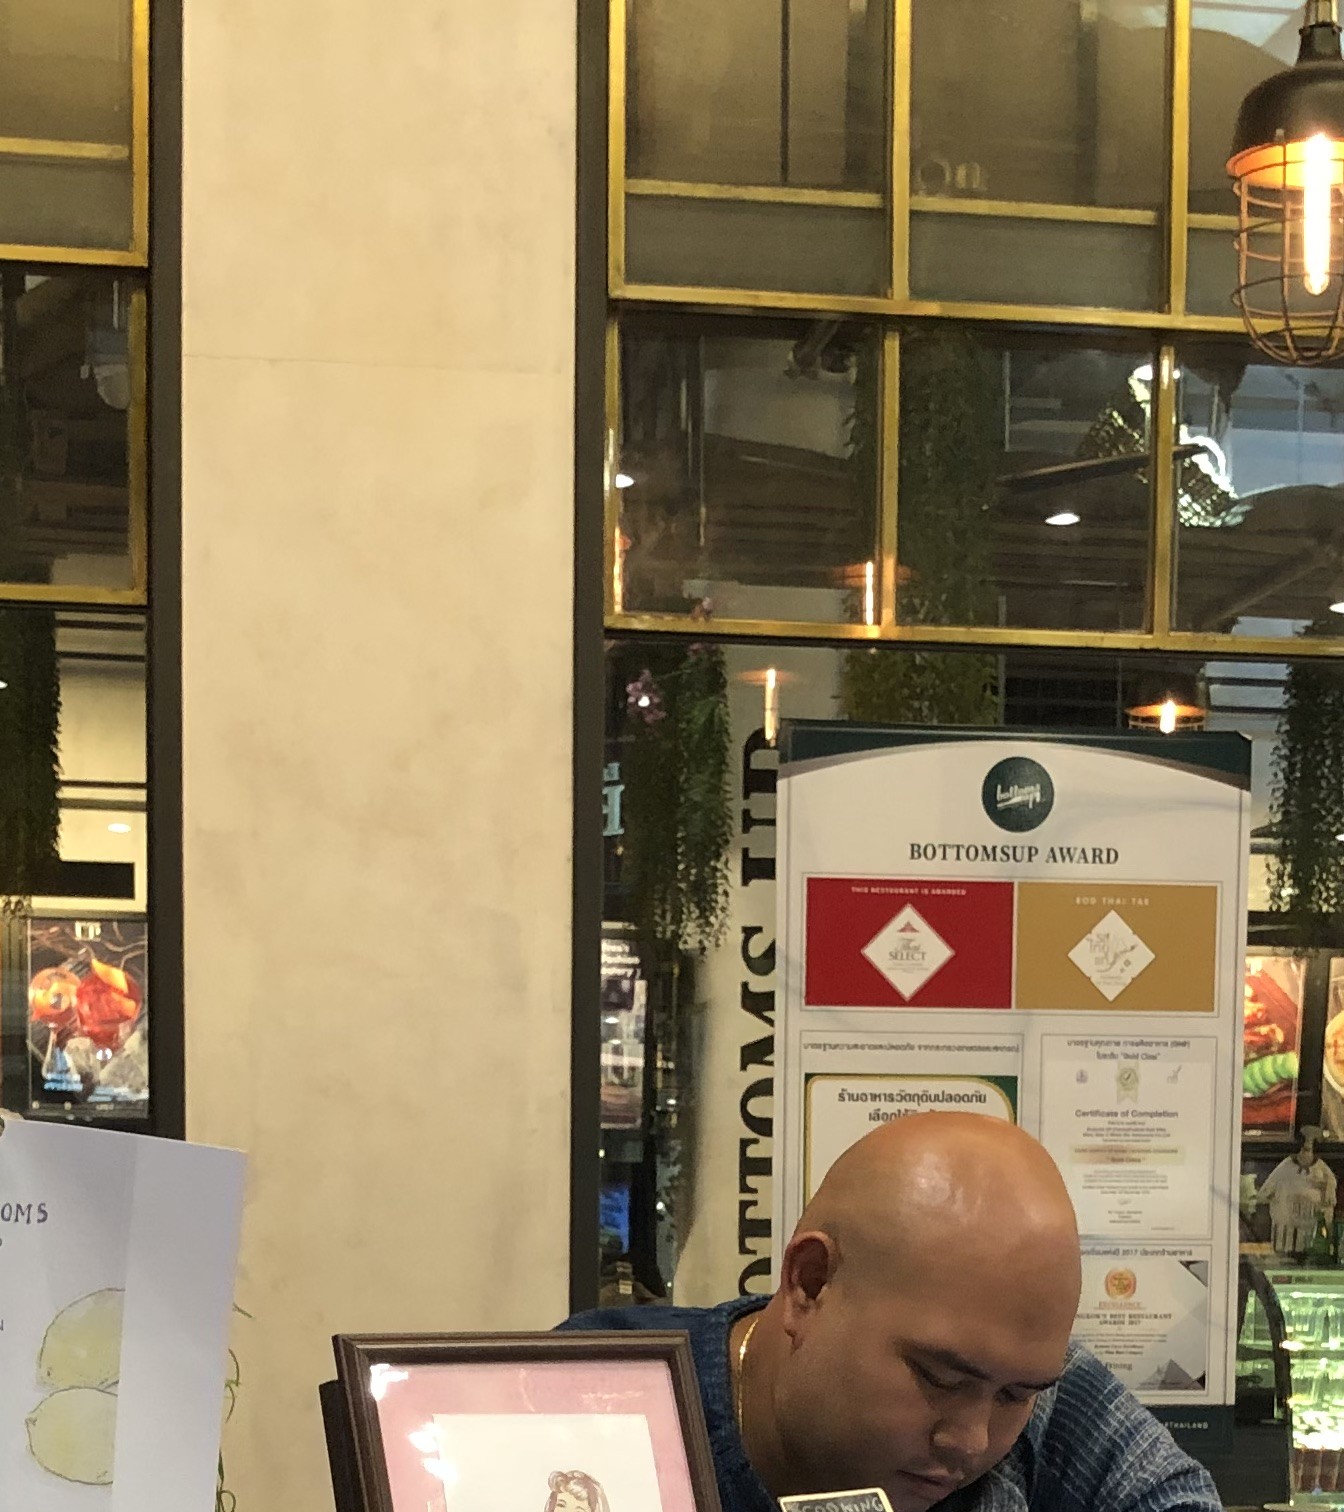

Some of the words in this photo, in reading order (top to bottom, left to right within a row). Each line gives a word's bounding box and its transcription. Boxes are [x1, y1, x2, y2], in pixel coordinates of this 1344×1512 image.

[909, 842, 1039, 863] BOTTOMSUP
[1045, 846, 1119, 865] AWARD
[889, 951, 927, 961] SELECT
[1075, 1109, 1118, 1117] Certificate
[1131, 1109, 1178, 1118] Completion
